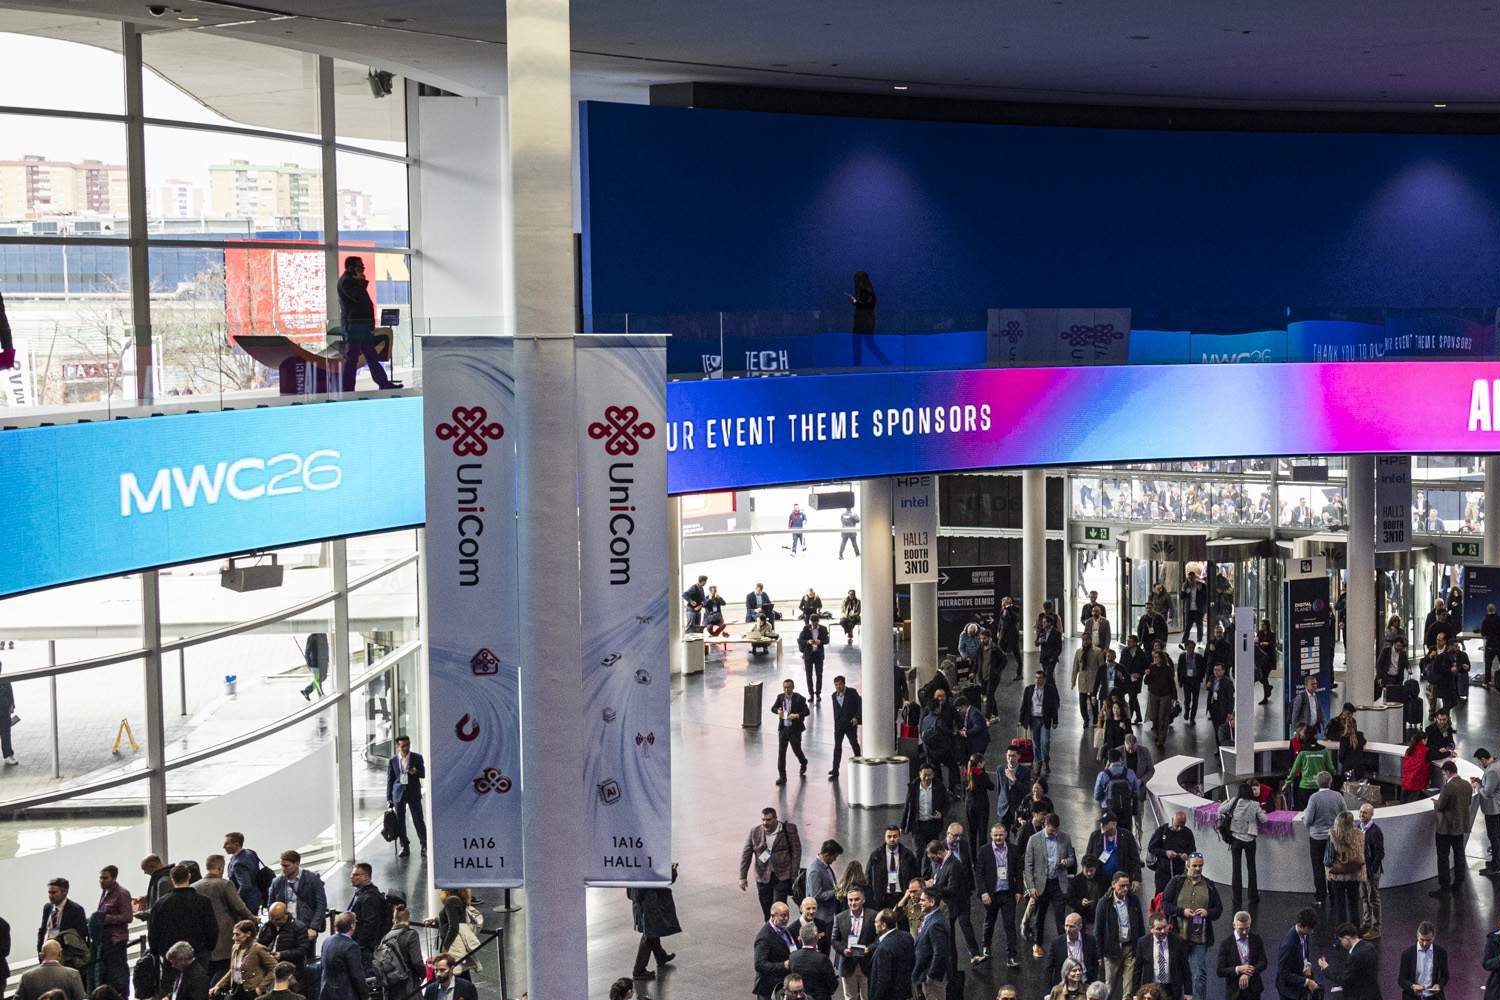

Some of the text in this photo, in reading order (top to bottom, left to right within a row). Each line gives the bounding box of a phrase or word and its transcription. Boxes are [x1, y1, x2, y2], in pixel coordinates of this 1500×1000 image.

[666, 404, 992, 452] UR EVENT THEME SPONSORS
[120, 449, 343, 517] MWC26
[900, 495, 929, 508] intel
[904, 549, 929, 560] BOOTH
[904, 560, 929, 574] 3N10
[461, 836, 496, 850] 1A16
[612, 836, 644, 849] 1A16
[453, 856, 505, 870] HALL 1
[603, 856, 653, 868] HALL 1
